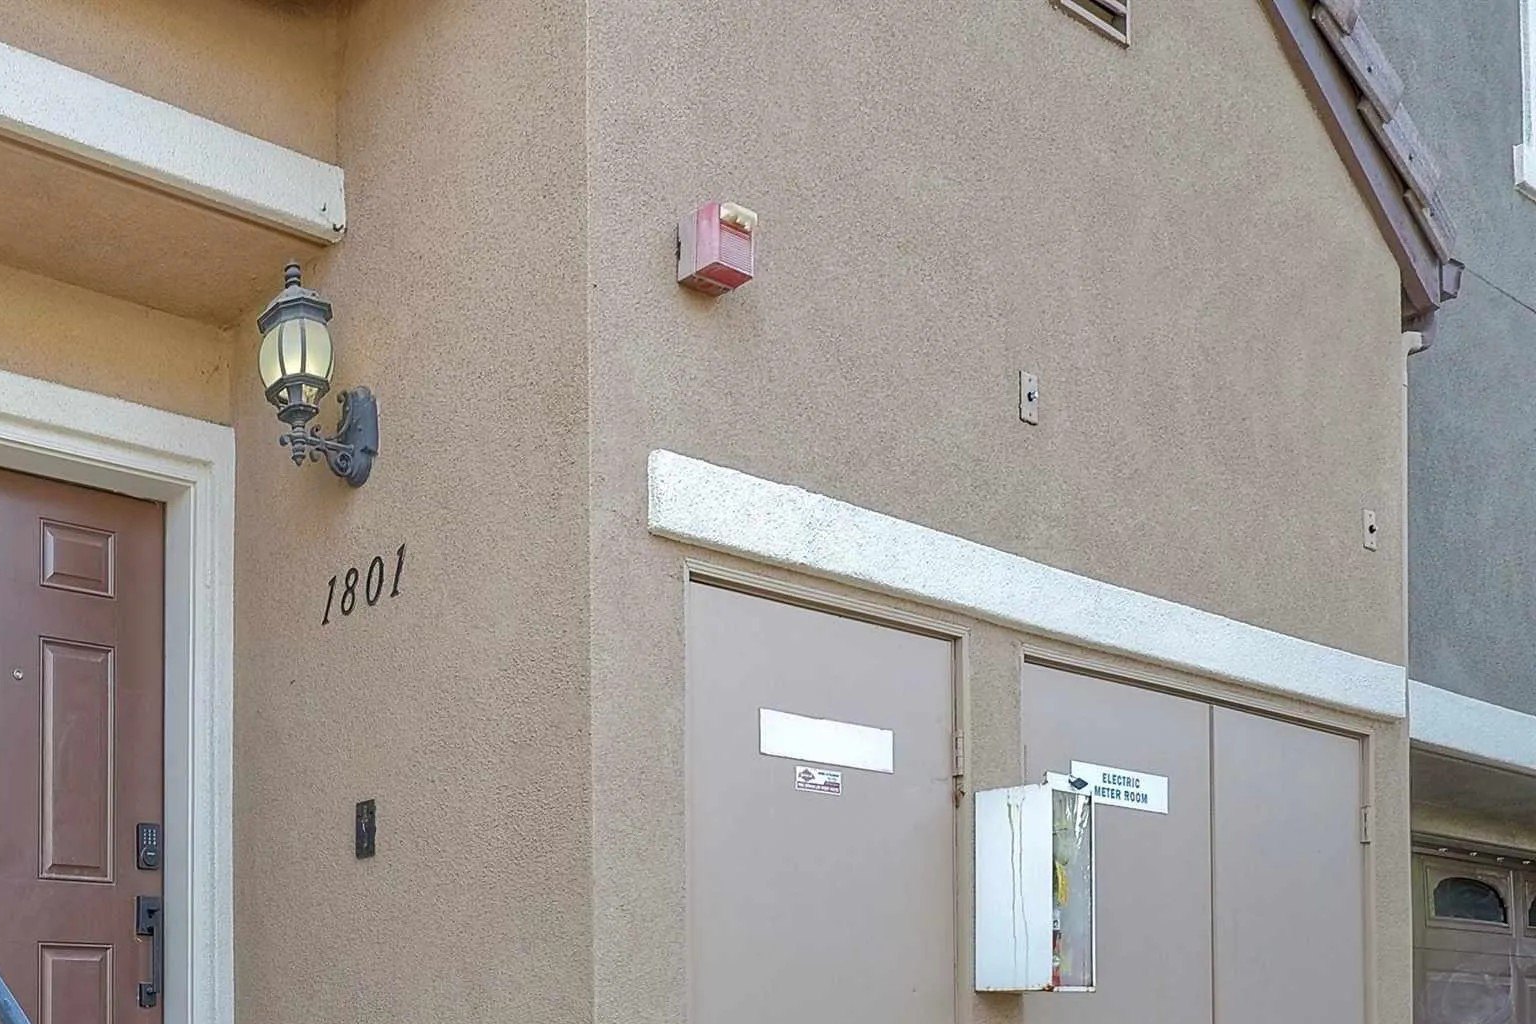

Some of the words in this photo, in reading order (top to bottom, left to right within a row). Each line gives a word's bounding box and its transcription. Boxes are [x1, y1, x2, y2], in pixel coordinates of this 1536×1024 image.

[321, 543, 406, 626] 1801
[1102, 772, 1140, 788] ELECTRIC
[1094, 785, 1121, 800] METER
[1124, 790, 1148, 804] ROOM
